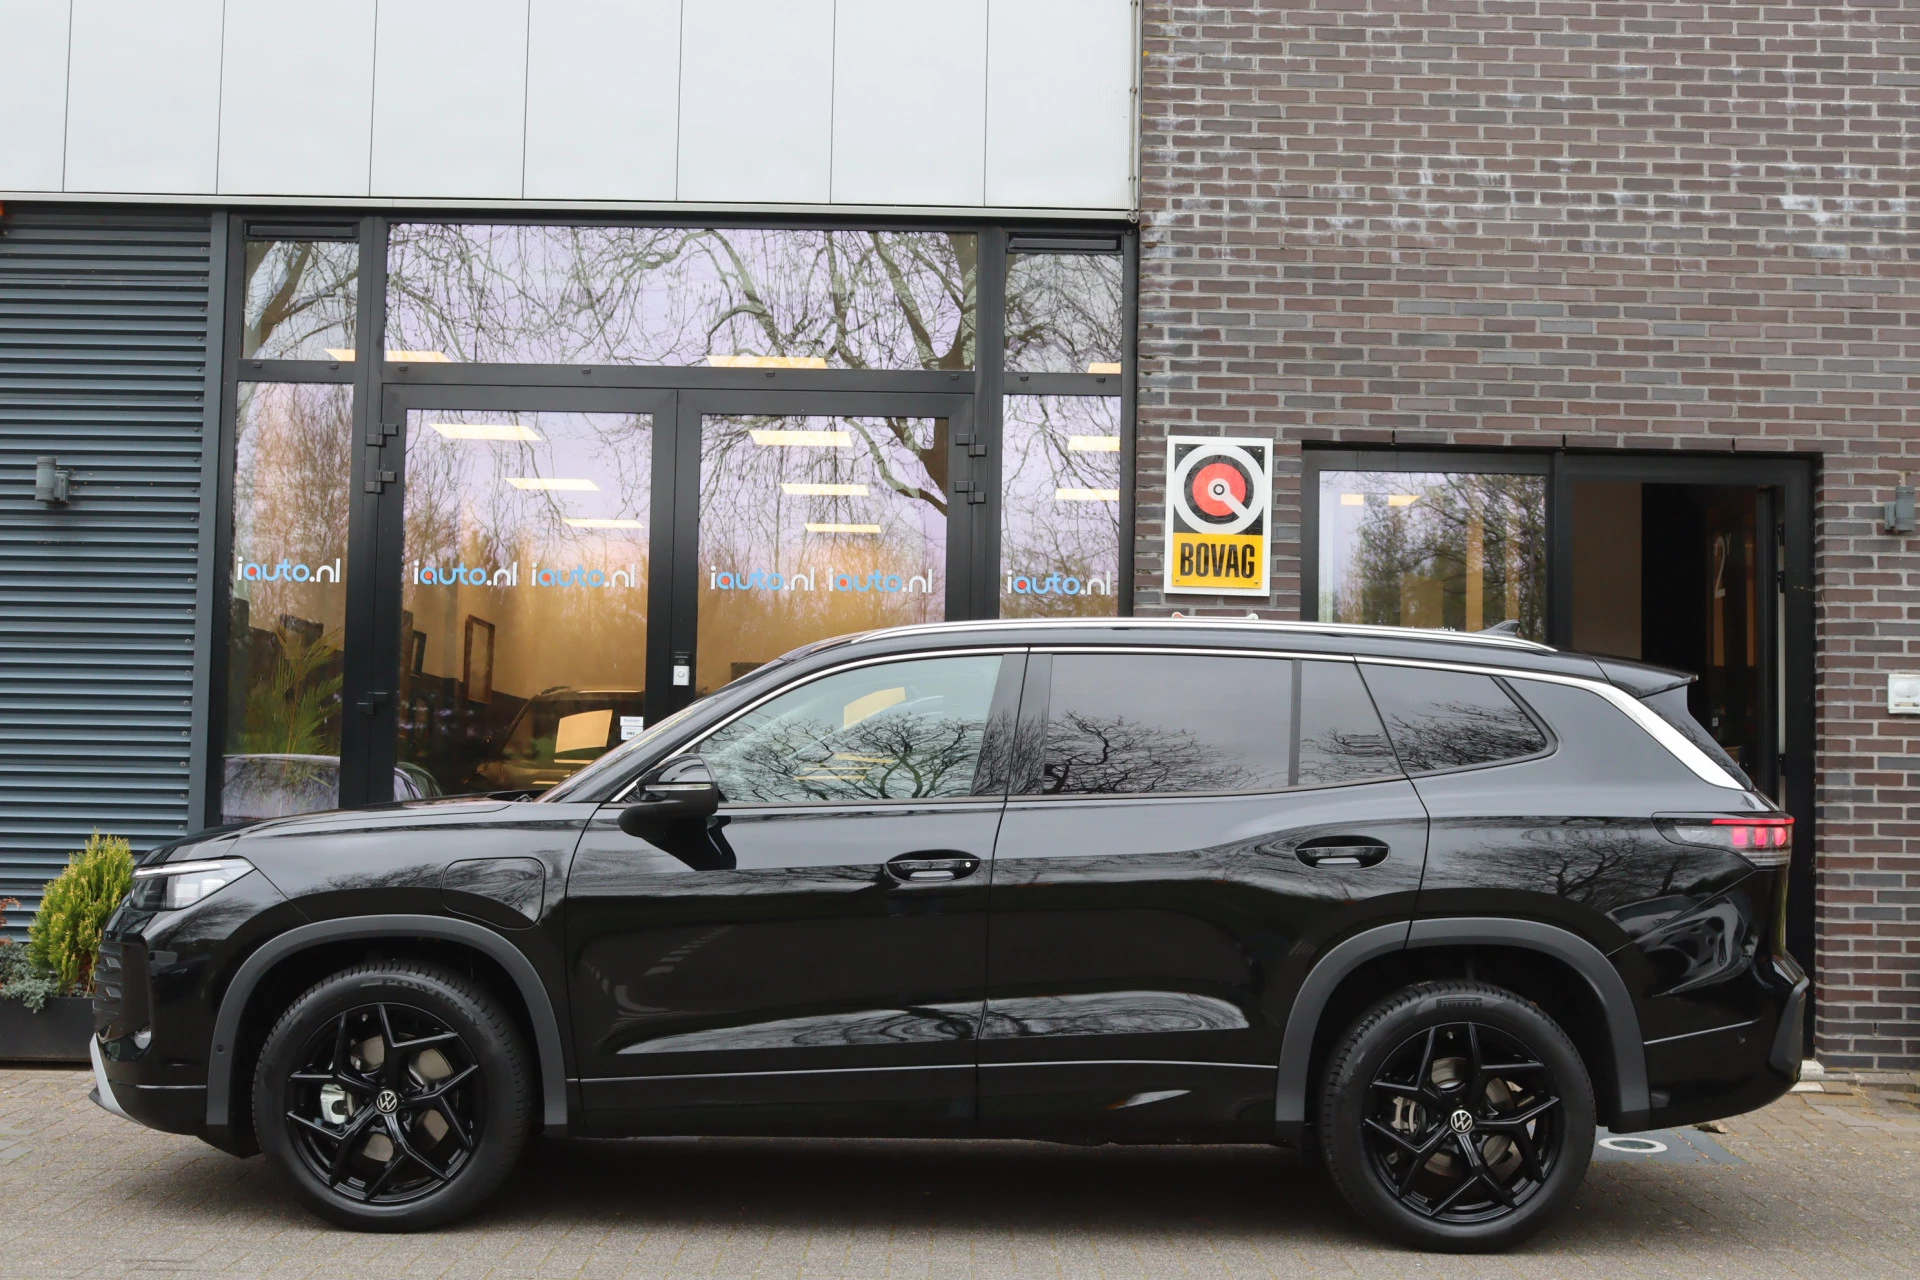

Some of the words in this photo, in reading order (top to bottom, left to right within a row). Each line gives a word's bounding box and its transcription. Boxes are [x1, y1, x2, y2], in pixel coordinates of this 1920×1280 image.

[237, 556, 340, 583] iauto.nl
[414, 560, 517, 587] iauto.nl
[531, 562, 635, 588] iauto.nl
[1180, 543, 1255, 579] BOVAG
[710, 565, 815, 592] iauto.nl
[828, 567, 933, 594] iauto.nl
[1007, 569, 1111, 596] iauto.nl
